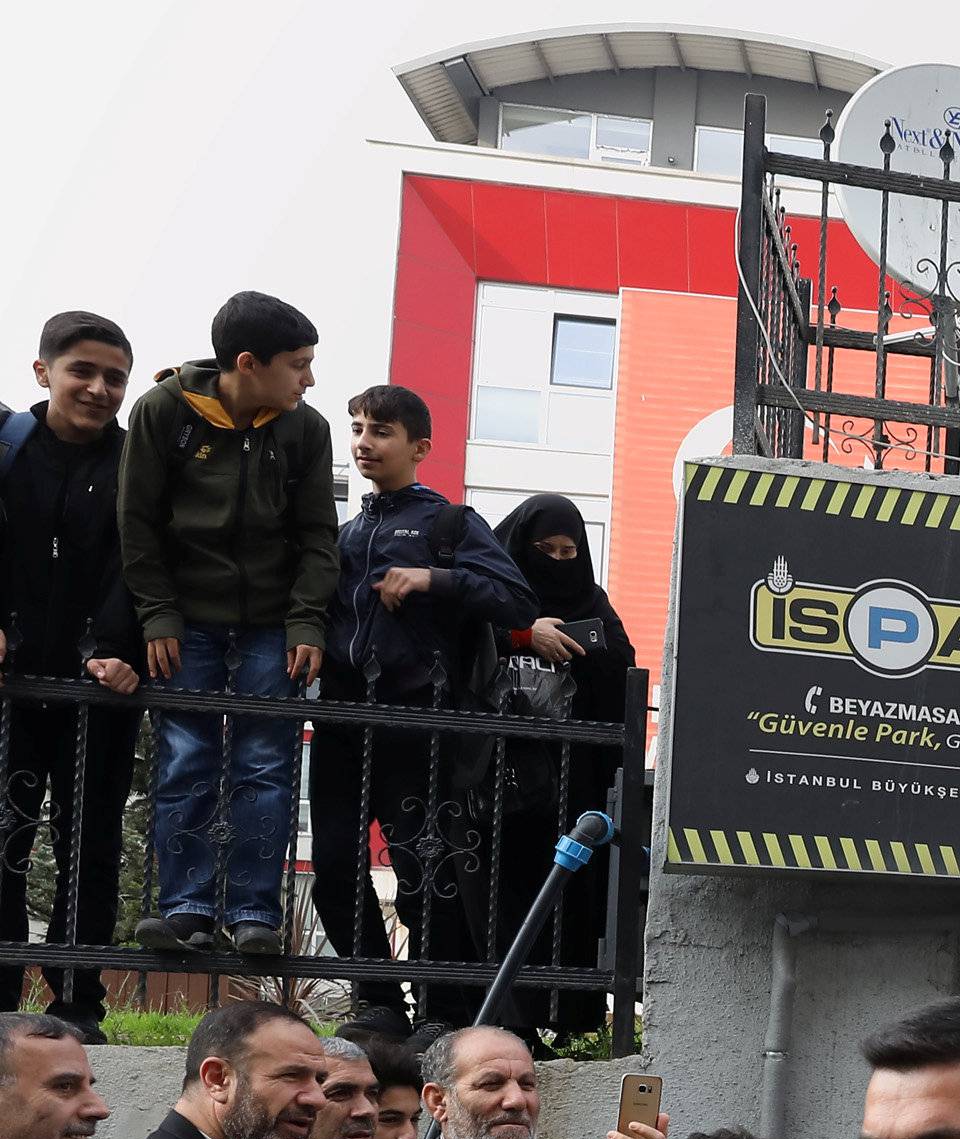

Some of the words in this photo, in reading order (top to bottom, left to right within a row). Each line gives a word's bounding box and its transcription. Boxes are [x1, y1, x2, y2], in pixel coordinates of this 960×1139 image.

[830, 697, 960, 726] BEYAZMASA
[875, 725, 942, 751] Park,
[767, 770, 862, 790] İSTANBUL
